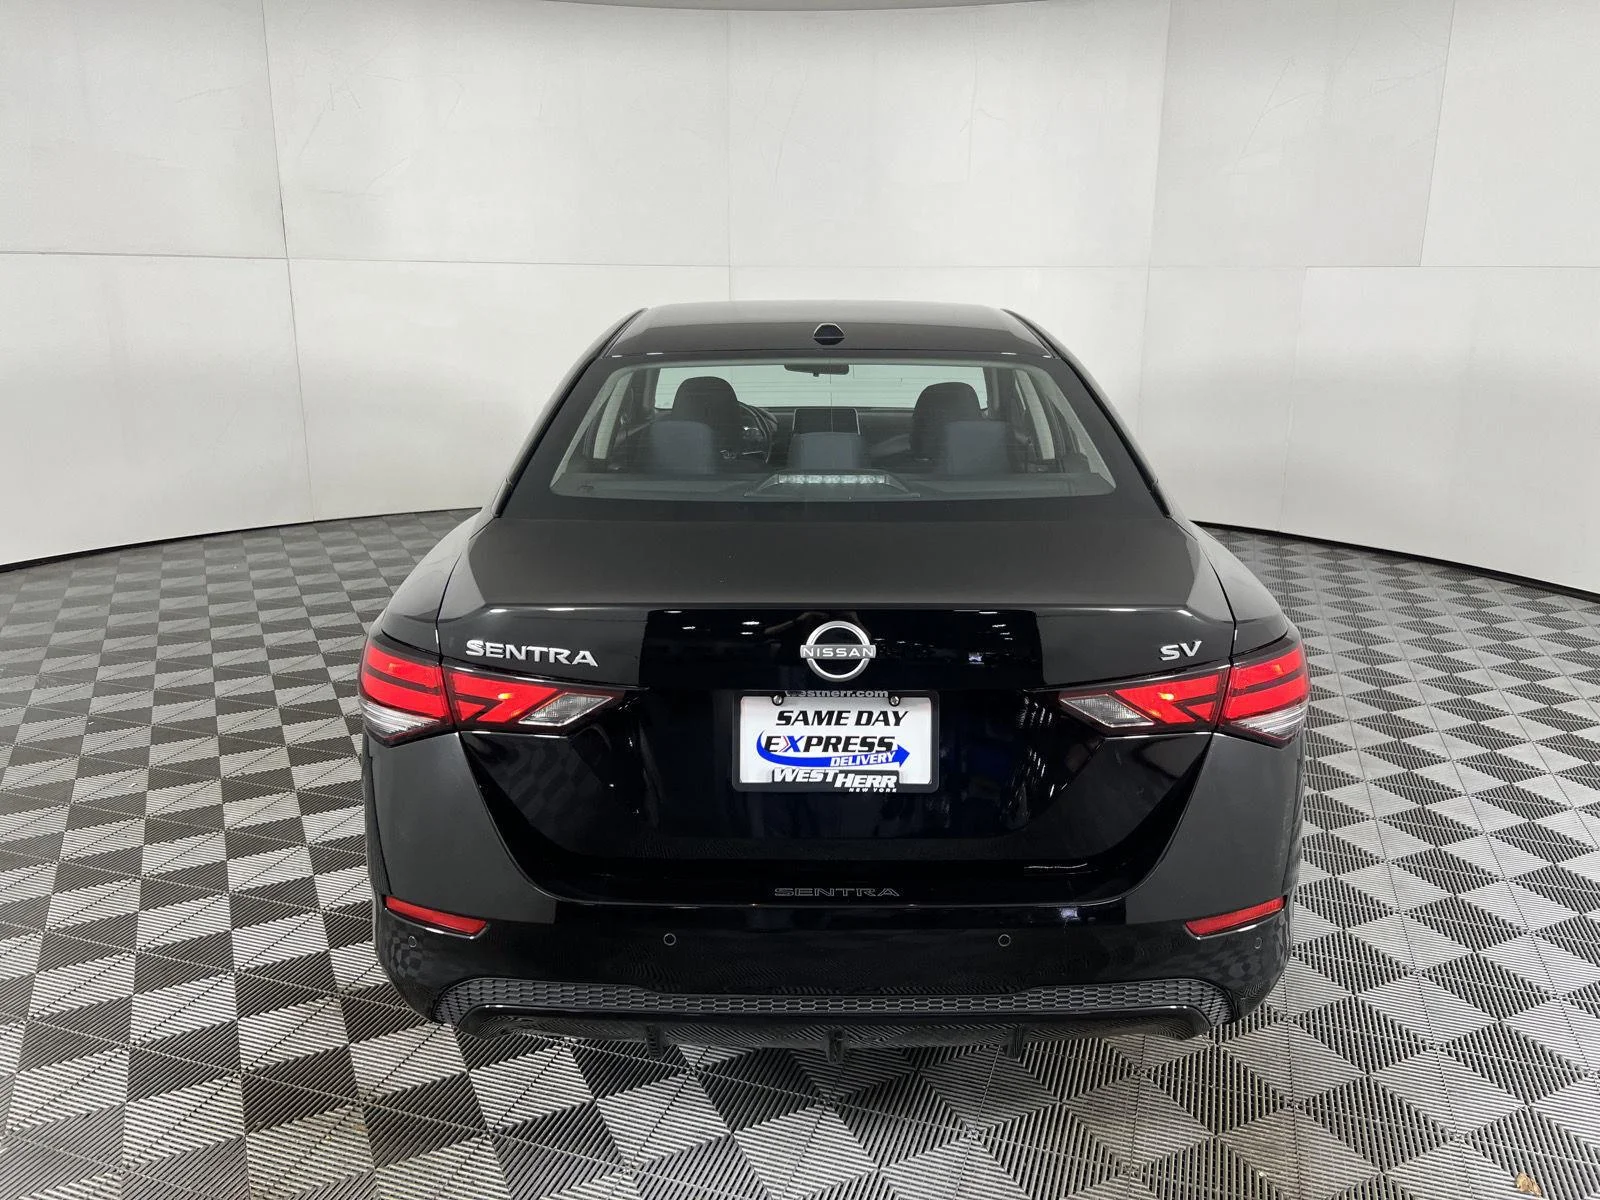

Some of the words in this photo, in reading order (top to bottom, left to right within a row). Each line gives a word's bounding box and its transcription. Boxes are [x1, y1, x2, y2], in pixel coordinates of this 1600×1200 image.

[466, 639, 599, 667] SENTRA
[803, 647, 874, 657] NISSAN
[1160, 640, 1202, 661] SV
[776, 710, 850, 726] SAME
[855, 710, 908, 726] DAY
[764, 735, 895, 753] EXPRESS
[830, 752, 896, 767] DELIVERY
[772, 767, 838, 783] WEST
[834, 774, 897, 788] HERR
[774, 887, 900, 897] SENTRA
